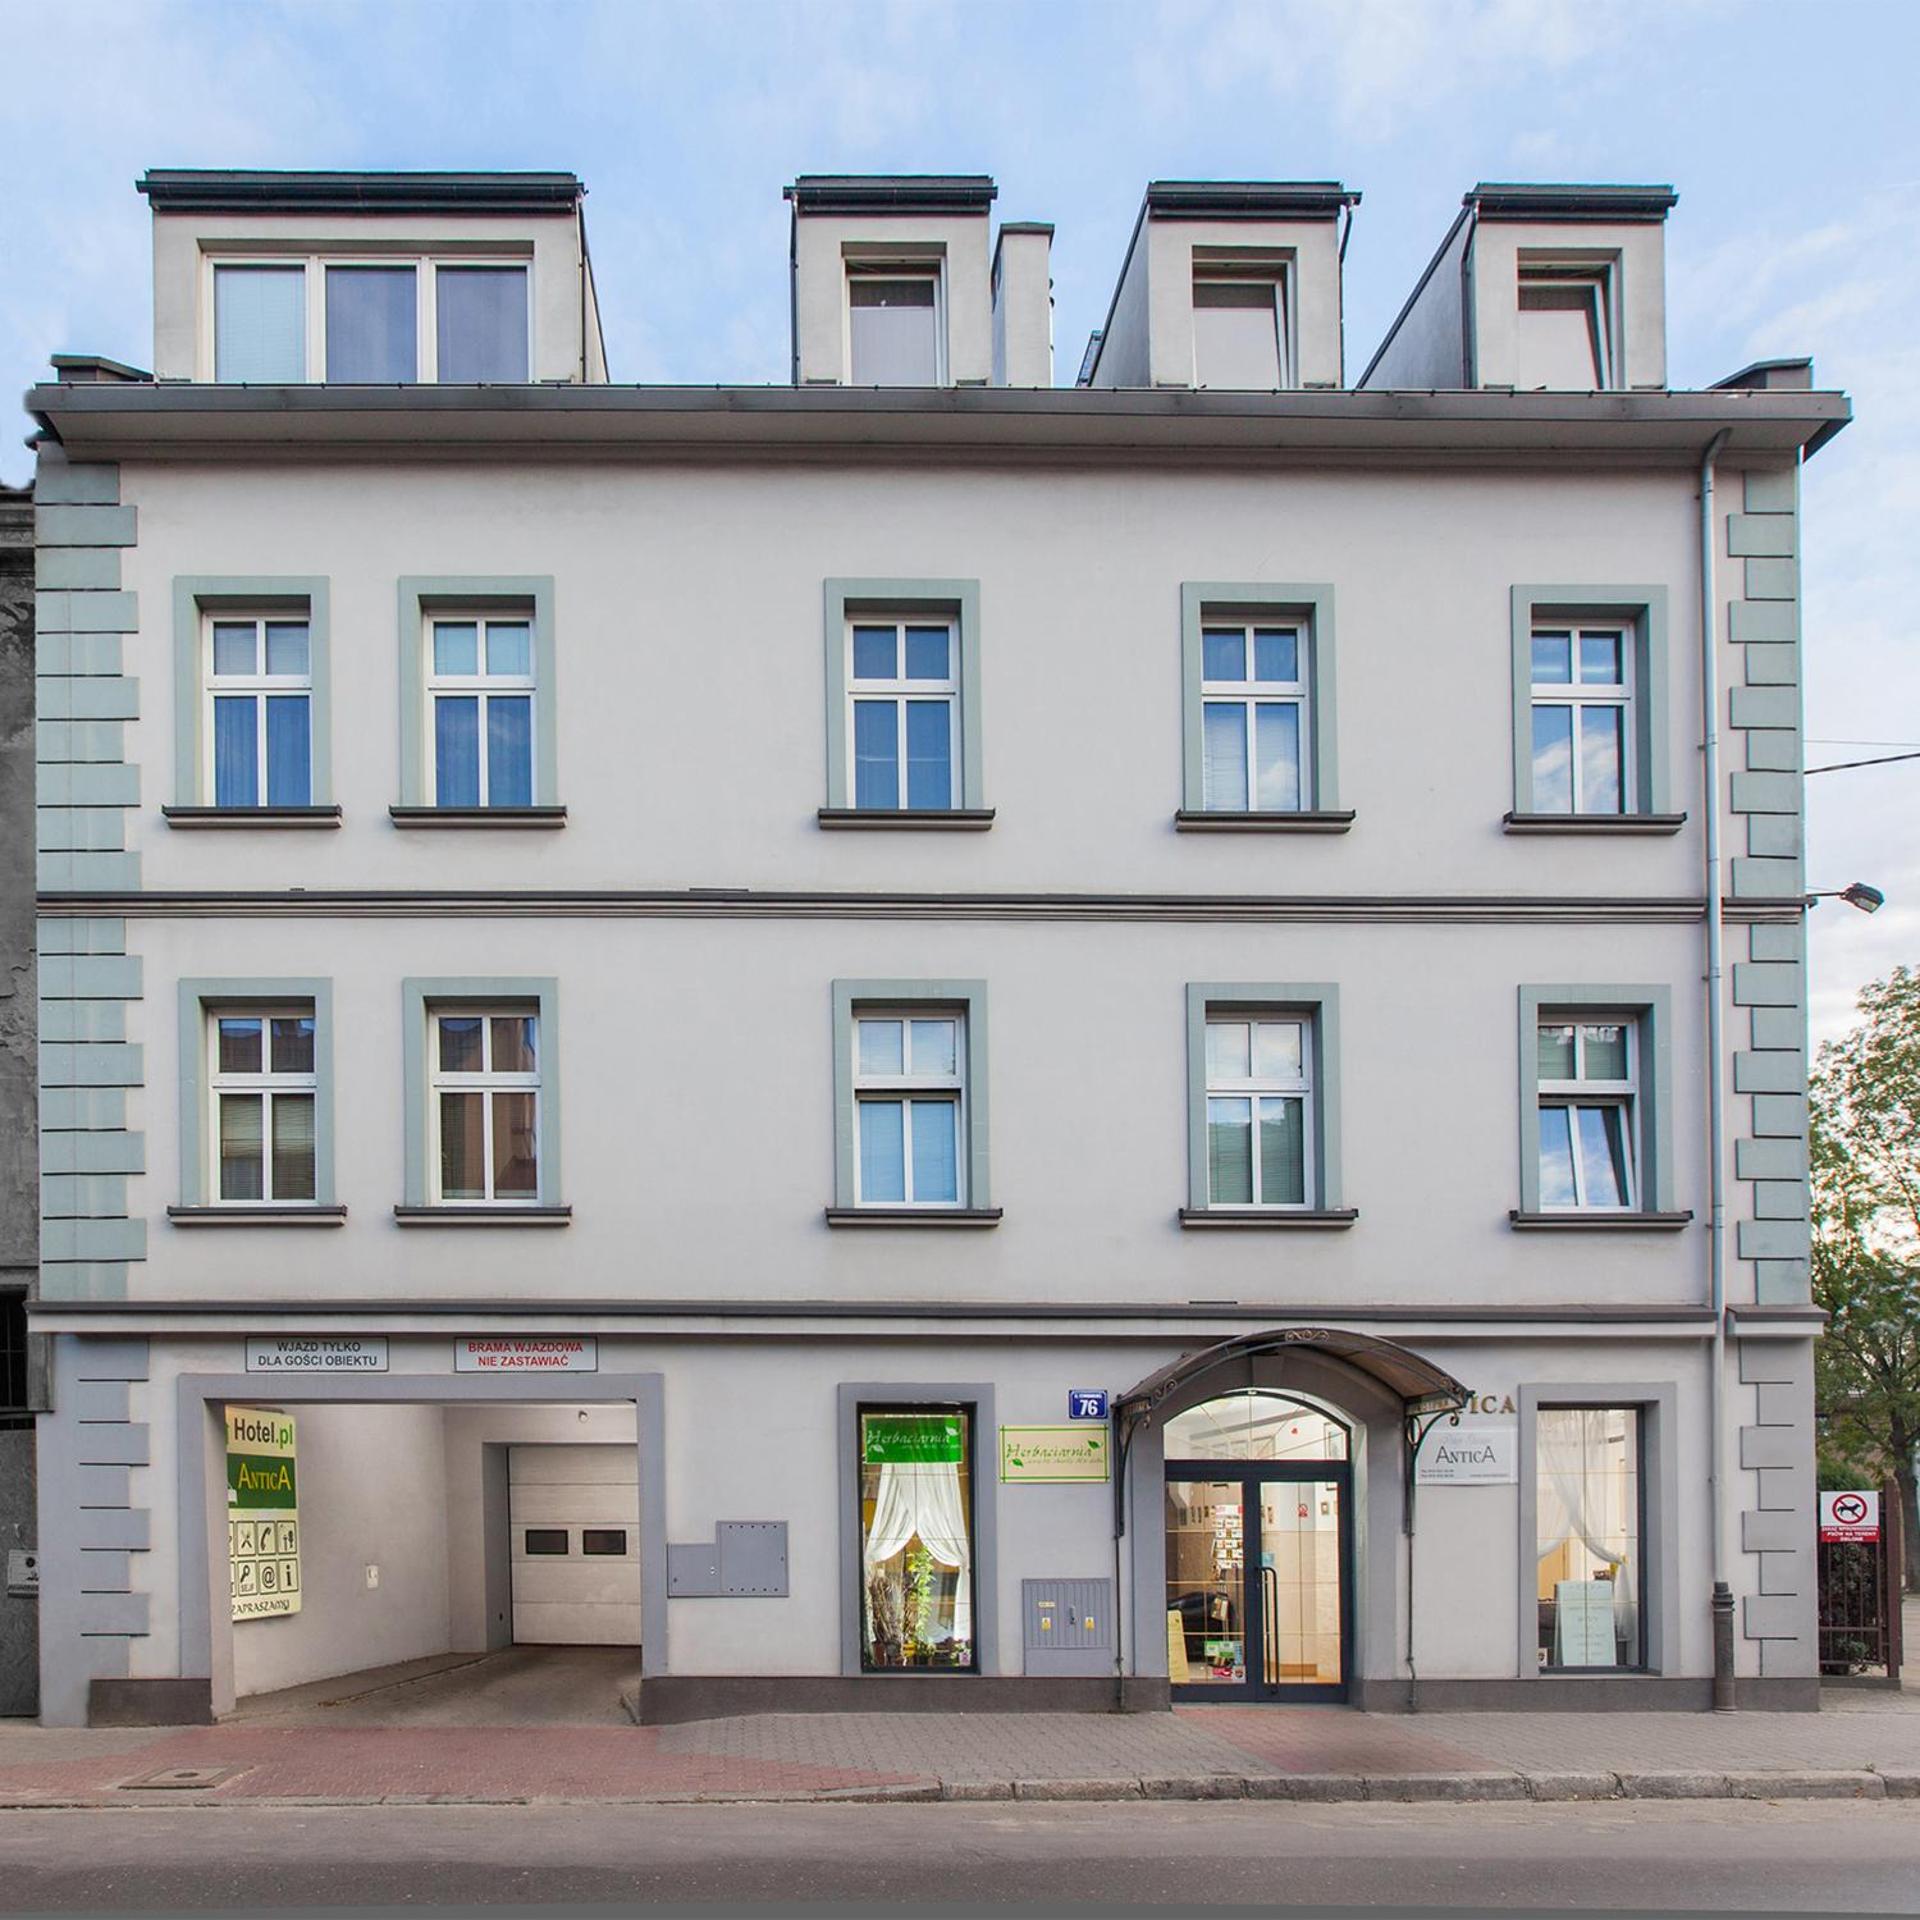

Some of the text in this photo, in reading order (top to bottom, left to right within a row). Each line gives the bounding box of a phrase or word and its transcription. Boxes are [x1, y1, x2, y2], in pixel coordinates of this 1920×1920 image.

[277, 1342, 361, 1352] WJAZD TYLKO
[468, 1342, 584, 1353] BRAMA WJAZDOWA
[258, 1354, 377, 1366] DLA GOŚCI OBIEKTU
[478, 1355, 569, 1367] NIE ZASTAWIAĆ
[1080, 1399, 1099, 1416] 76
[1460, 1395, 1516, 1414] ICA
[234, 1417, 293, 1450] Hotel.pl
[1006, 1444, 1092, 1458] Herbaciarnia
